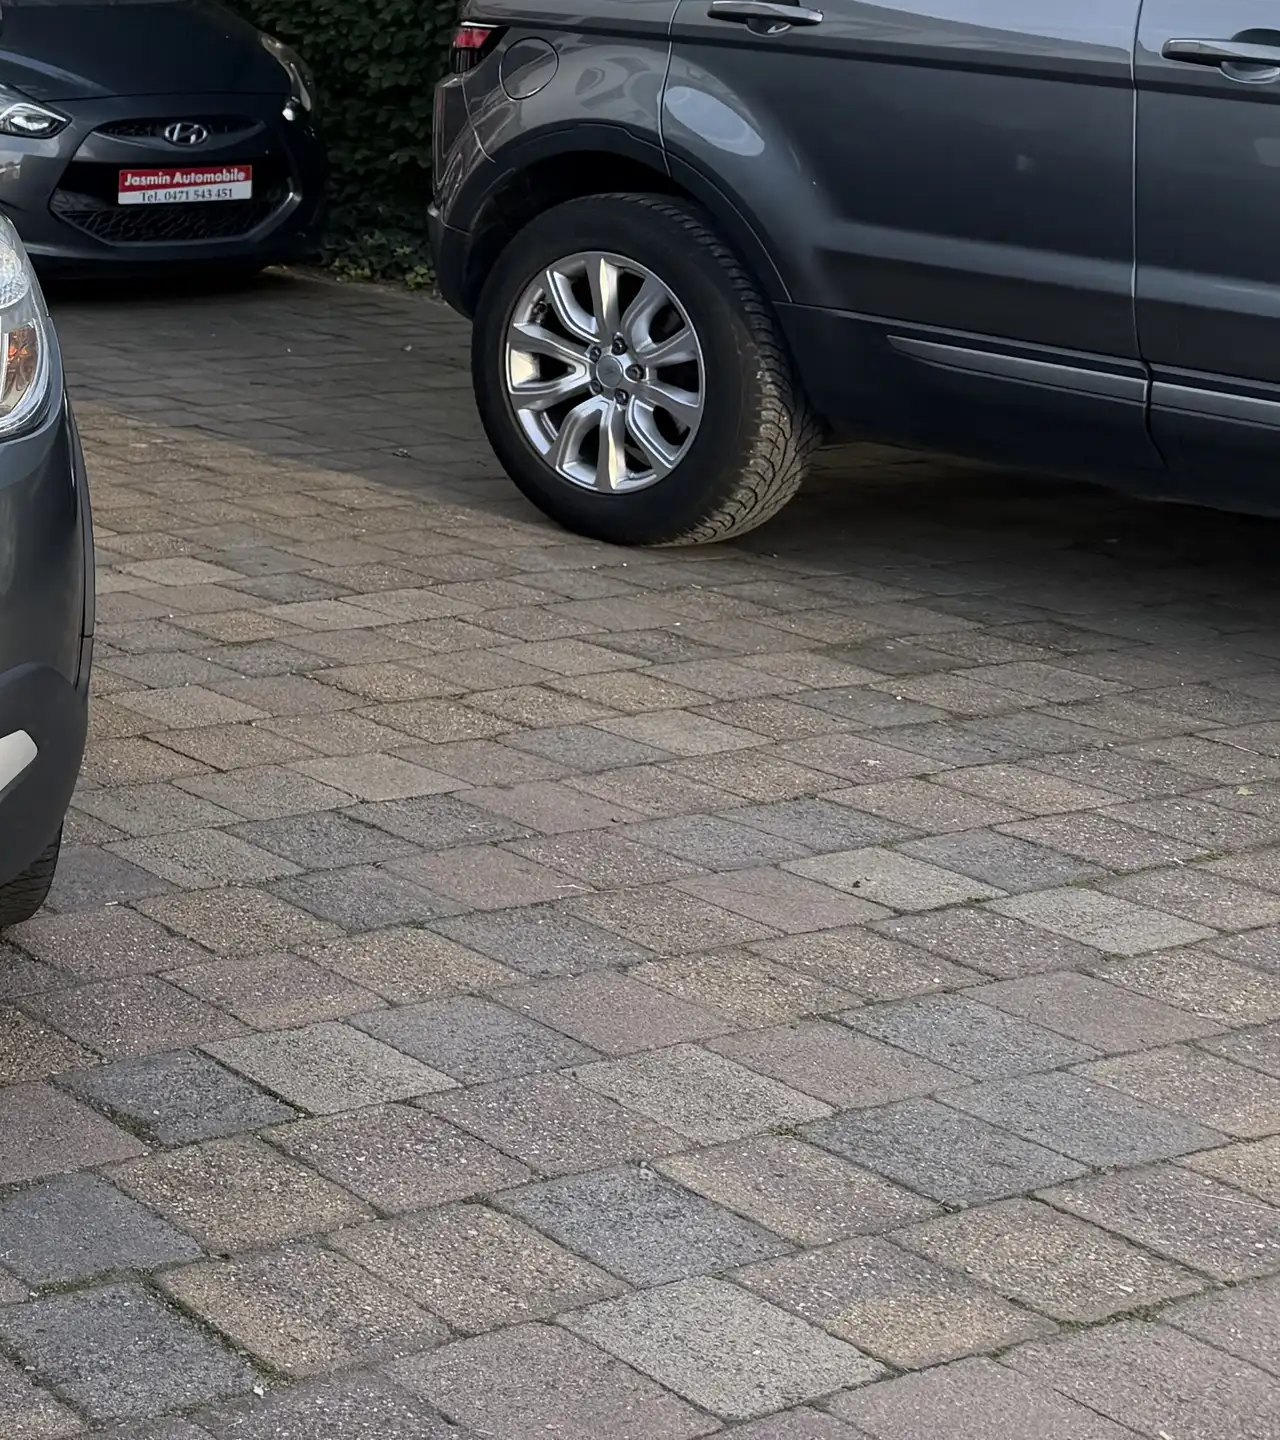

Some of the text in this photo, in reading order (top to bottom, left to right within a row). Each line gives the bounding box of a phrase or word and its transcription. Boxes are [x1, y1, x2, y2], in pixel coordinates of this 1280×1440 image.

[124, 168, 246, 186] Jasmin Automobile
[140, 188, 233, 202] Tel. 0471 543 451
